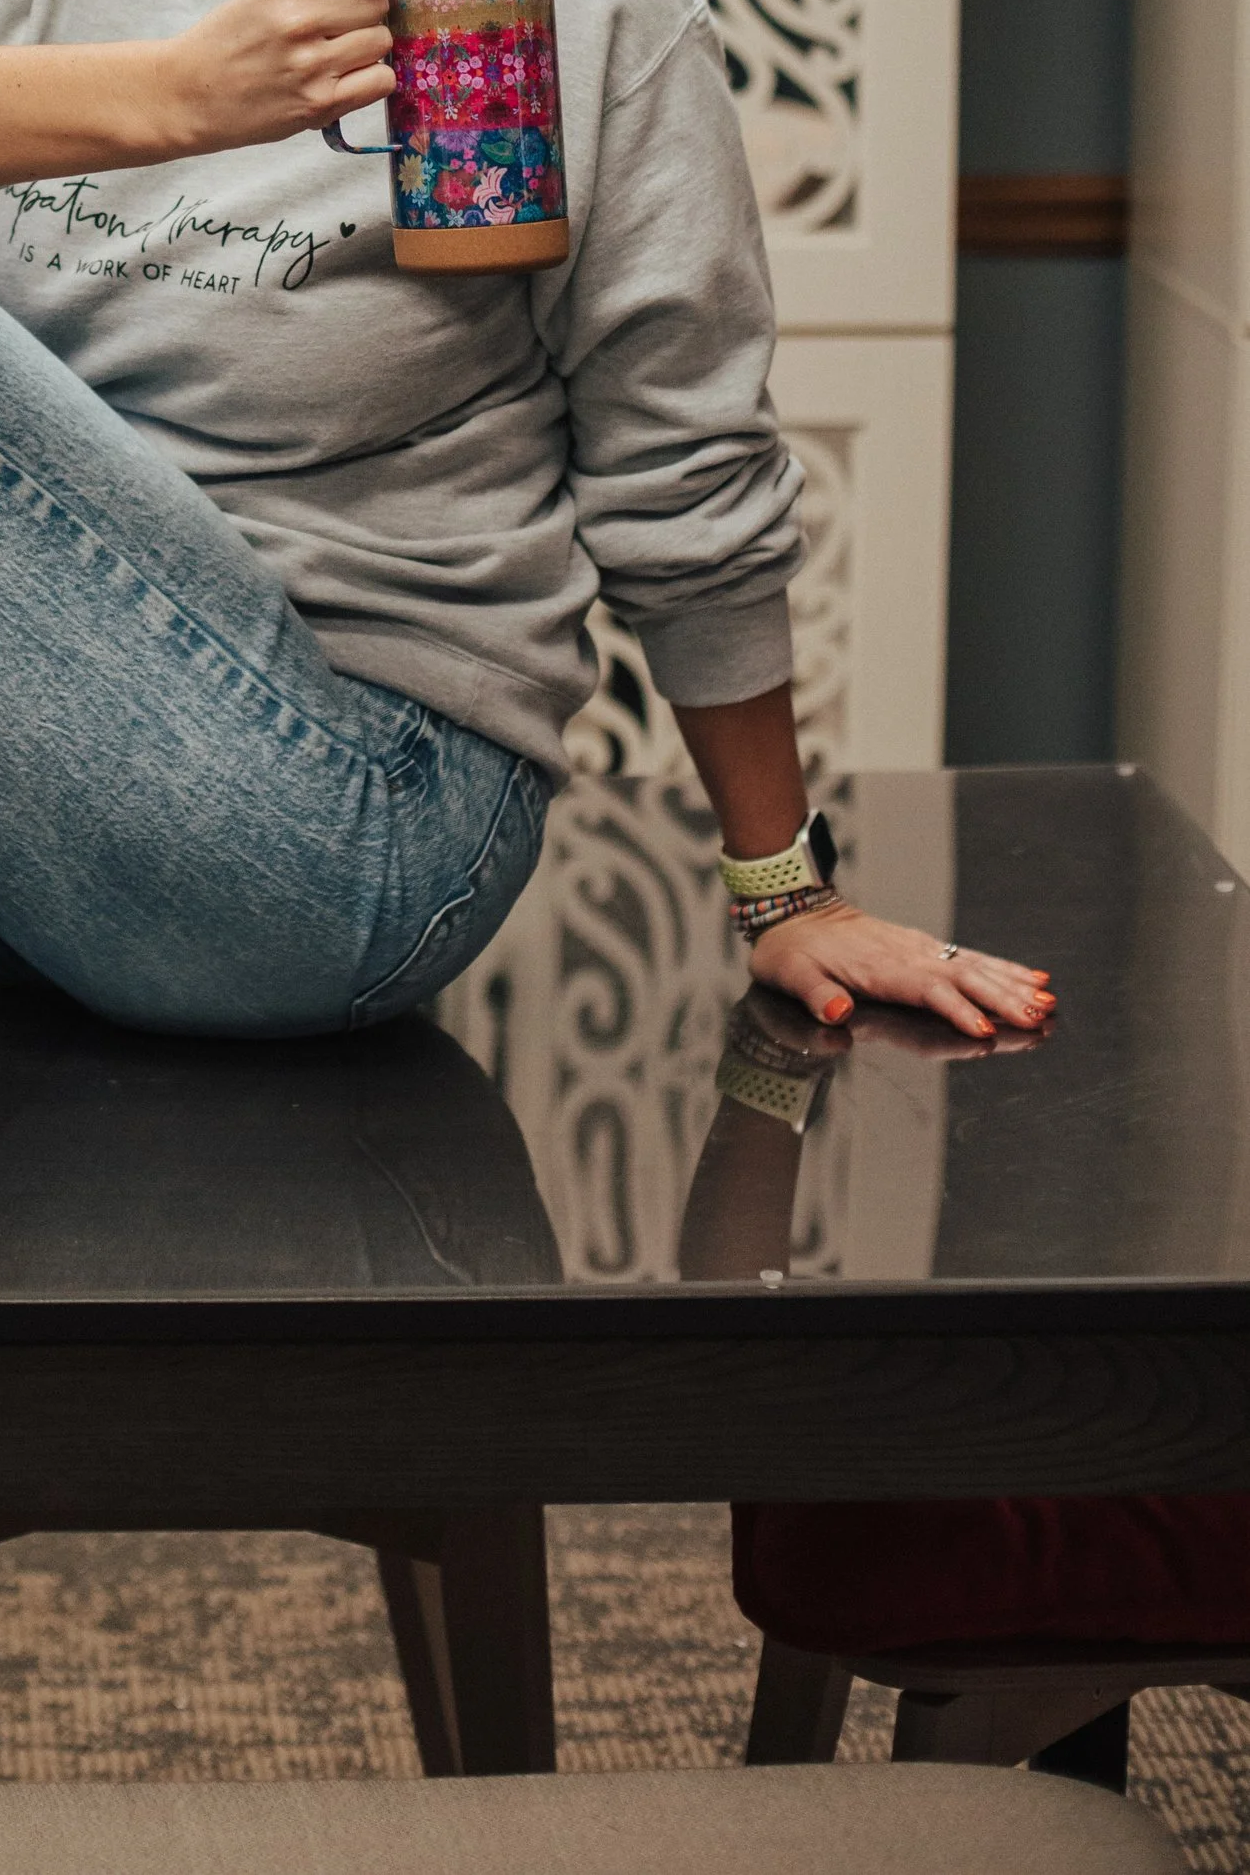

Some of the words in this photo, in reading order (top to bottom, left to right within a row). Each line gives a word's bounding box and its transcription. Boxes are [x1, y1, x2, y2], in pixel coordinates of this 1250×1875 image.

[18, 242, 36, 263] IS
[46, 252, 62, 272] A
[75, 258, 129, 279] WORK
[142, 262, 173, 282] OF
[180, 268, 241, 295] HEART
[168, 198, 331, 291] therapy
